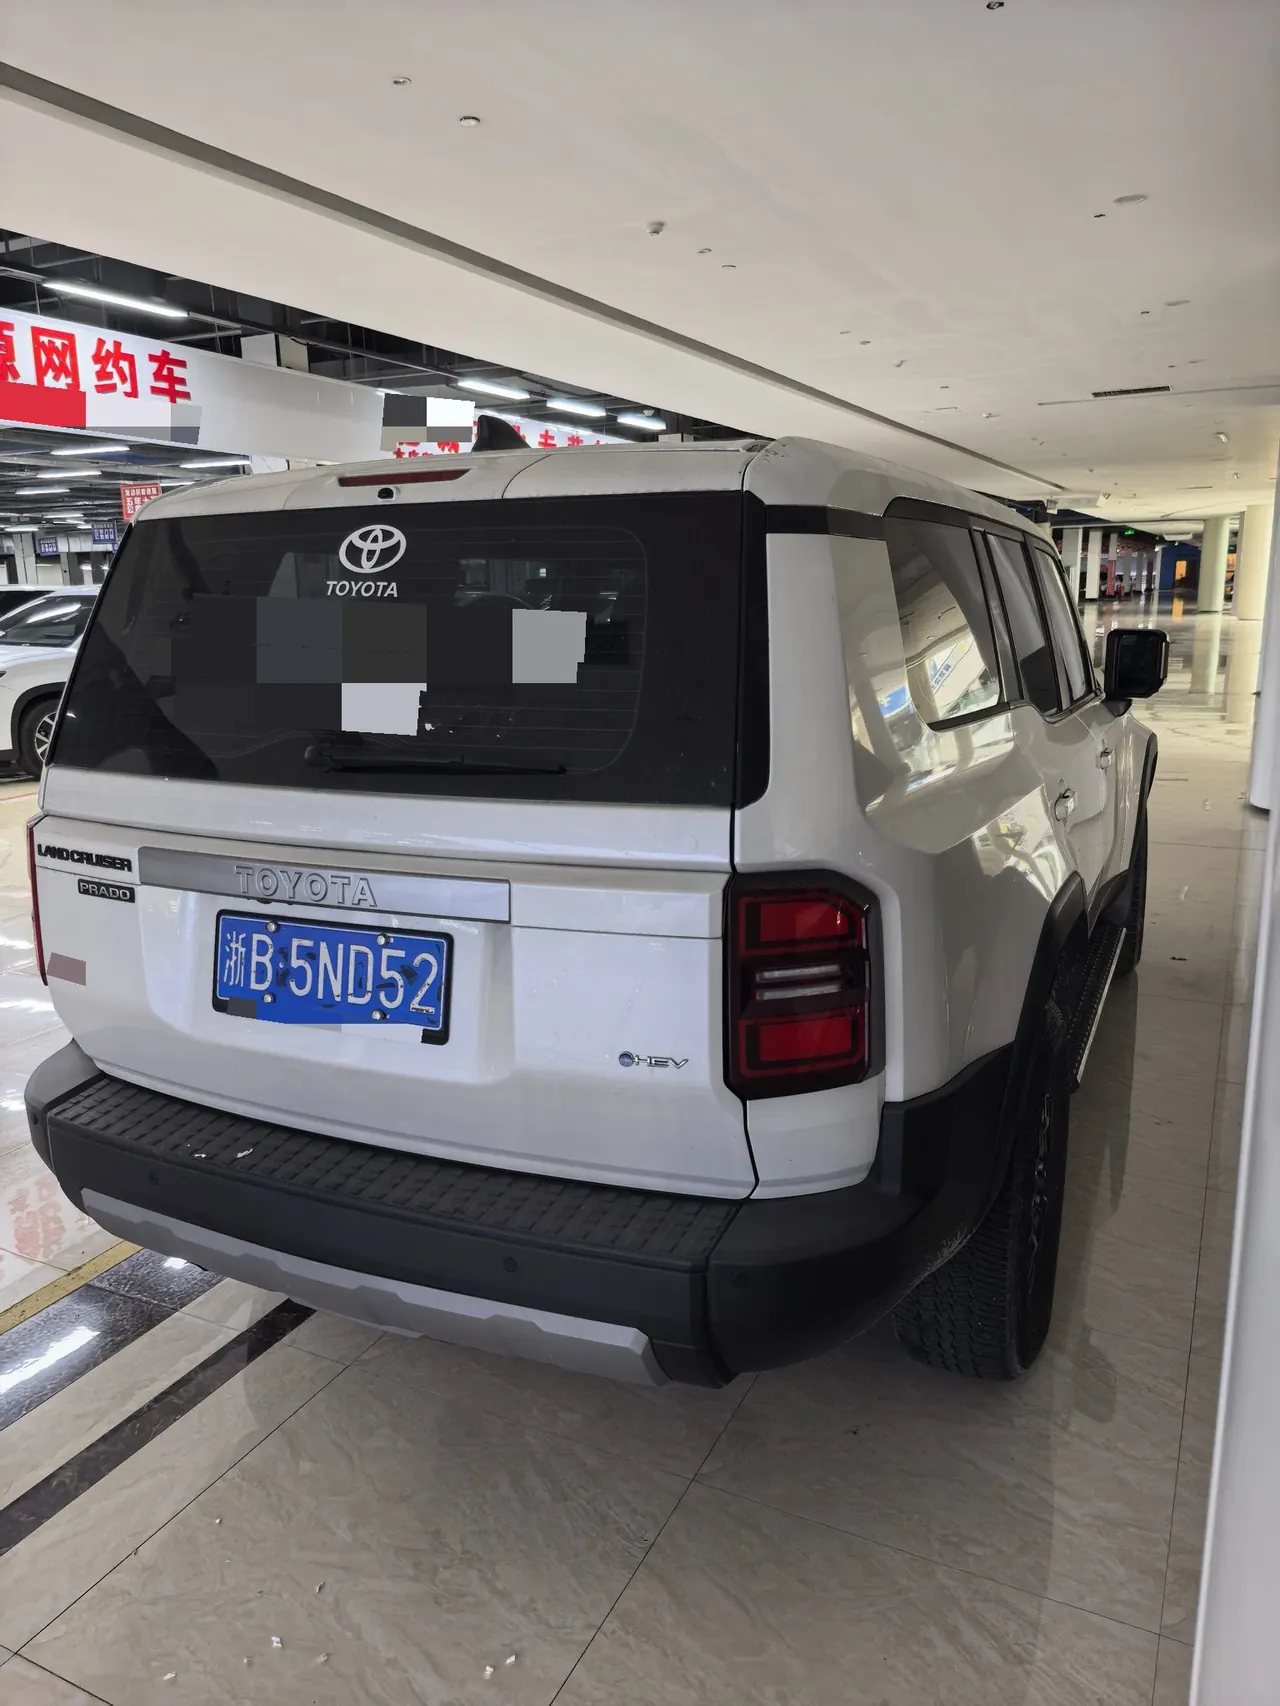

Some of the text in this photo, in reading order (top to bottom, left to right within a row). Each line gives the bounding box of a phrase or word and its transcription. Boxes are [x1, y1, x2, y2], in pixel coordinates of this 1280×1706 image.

[326, 581, 398, 598] TOYOTA
[37, 843, 133, 873] LAND CRUISER
[79, 882, 131, 900] PRADO
[234, 865, 378, 907] TOYOTA
[634, 1054, 689, 1069] HEV
